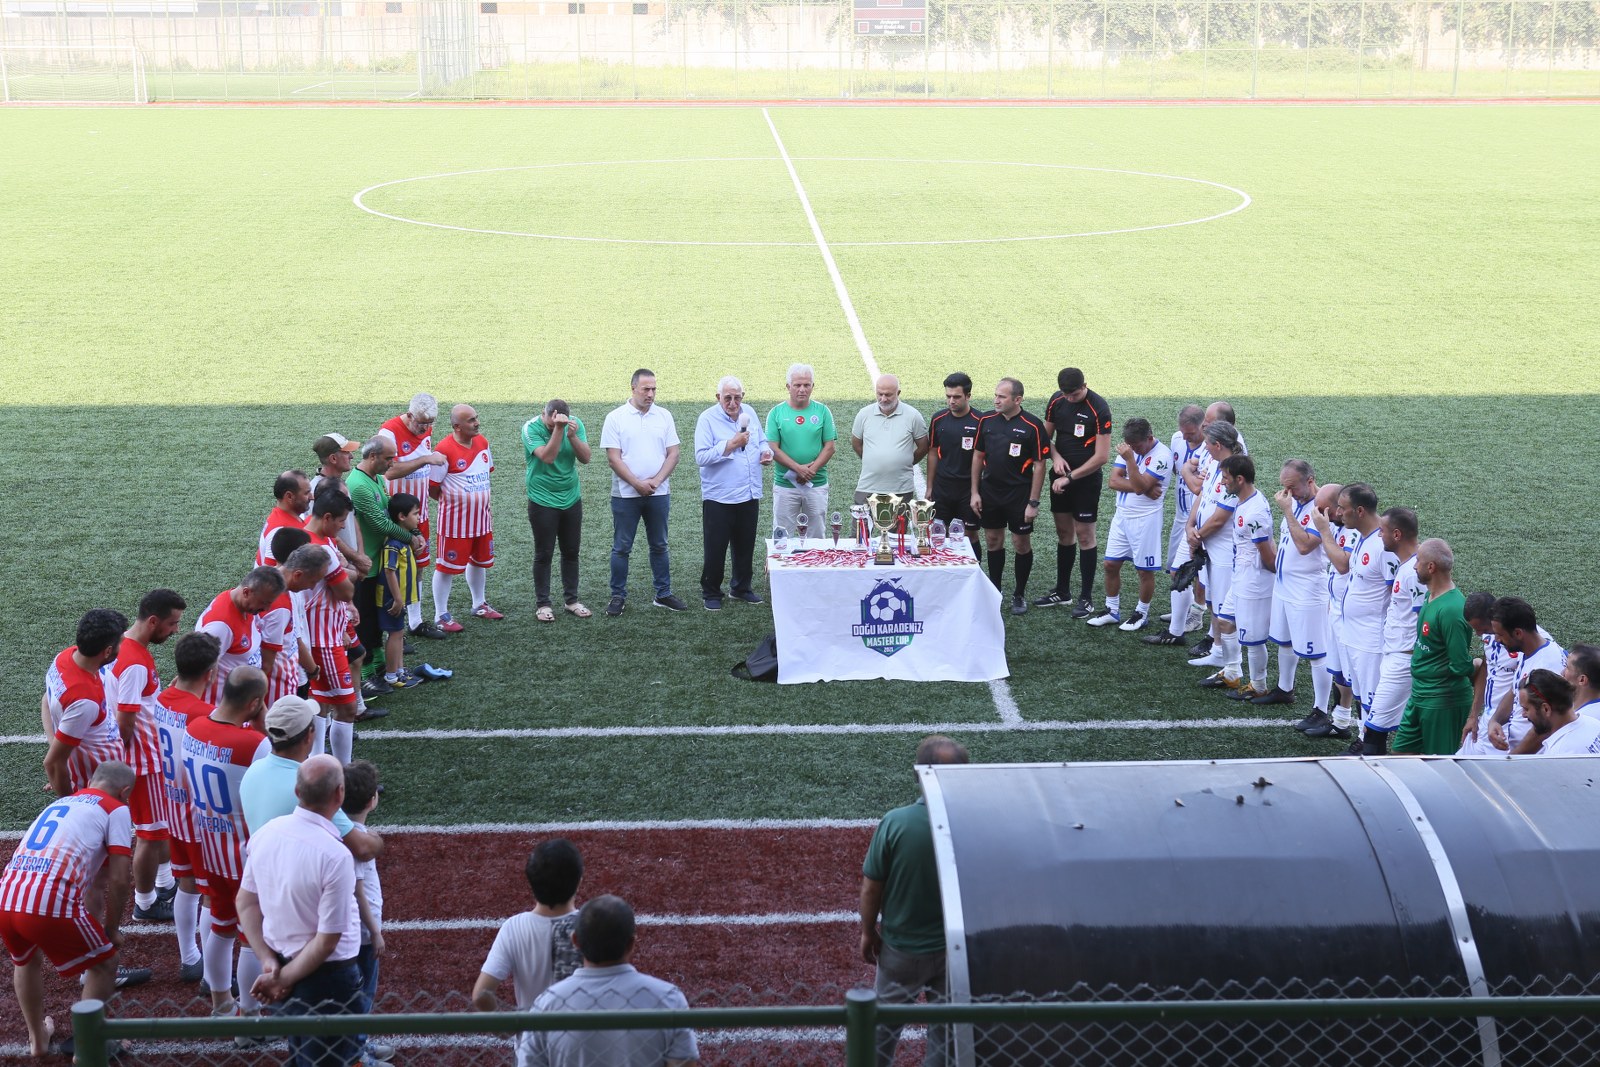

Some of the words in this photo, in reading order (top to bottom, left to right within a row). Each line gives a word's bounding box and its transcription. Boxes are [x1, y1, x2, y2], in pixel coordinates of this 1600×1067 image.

[1144, 555, 1155, 567] 10
[853, 623, 876, 635] DOĞU
[877, 622, 922, 634] KARADENİZ
[1239, 628, 1247, 641] 17
[867, 637, 895, 647] MASTER
[895, 636, 910, 645] CUP
[1307, 642, 1314, 654] 5
[159, 727, 175, 781] 3
[218, 747, 233, 764] SK
[183, 756, 233, 815] 10
[26, 805, 70, 851] 6
[8, 854, 52, 873] VETERAN
